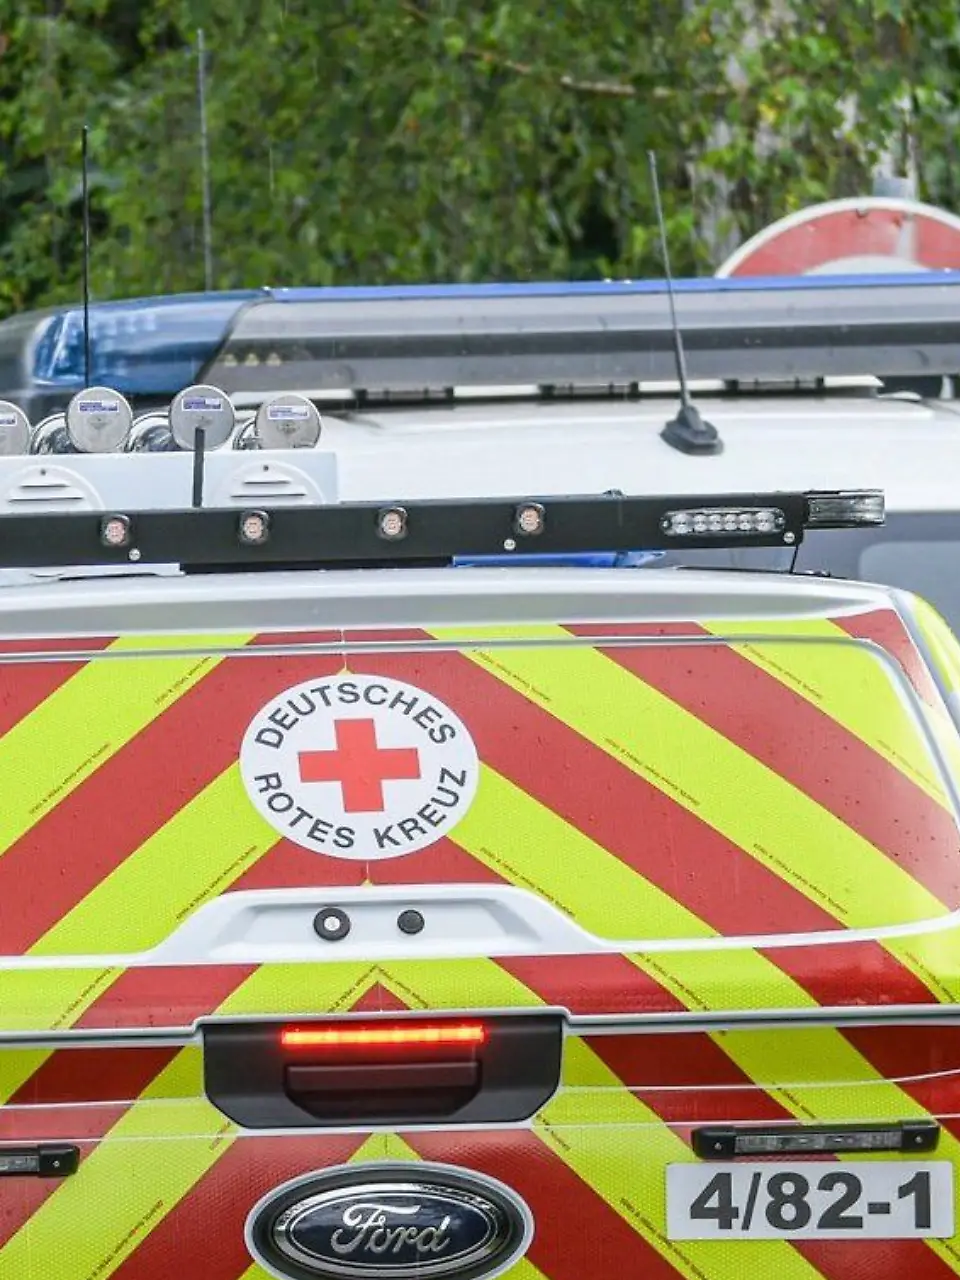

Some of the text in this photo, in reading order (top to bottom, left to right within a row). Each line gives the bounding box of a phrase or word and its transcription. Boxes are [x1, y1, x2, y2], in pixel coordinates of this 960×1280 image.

[254, 682, 456, 749] DEUTSCHES
[254, 767, 467, 848] ROTES KREUZ
[330, 1203, 451, 1253] Ford
[690, 1171, 931, 1230] 4/82-1
